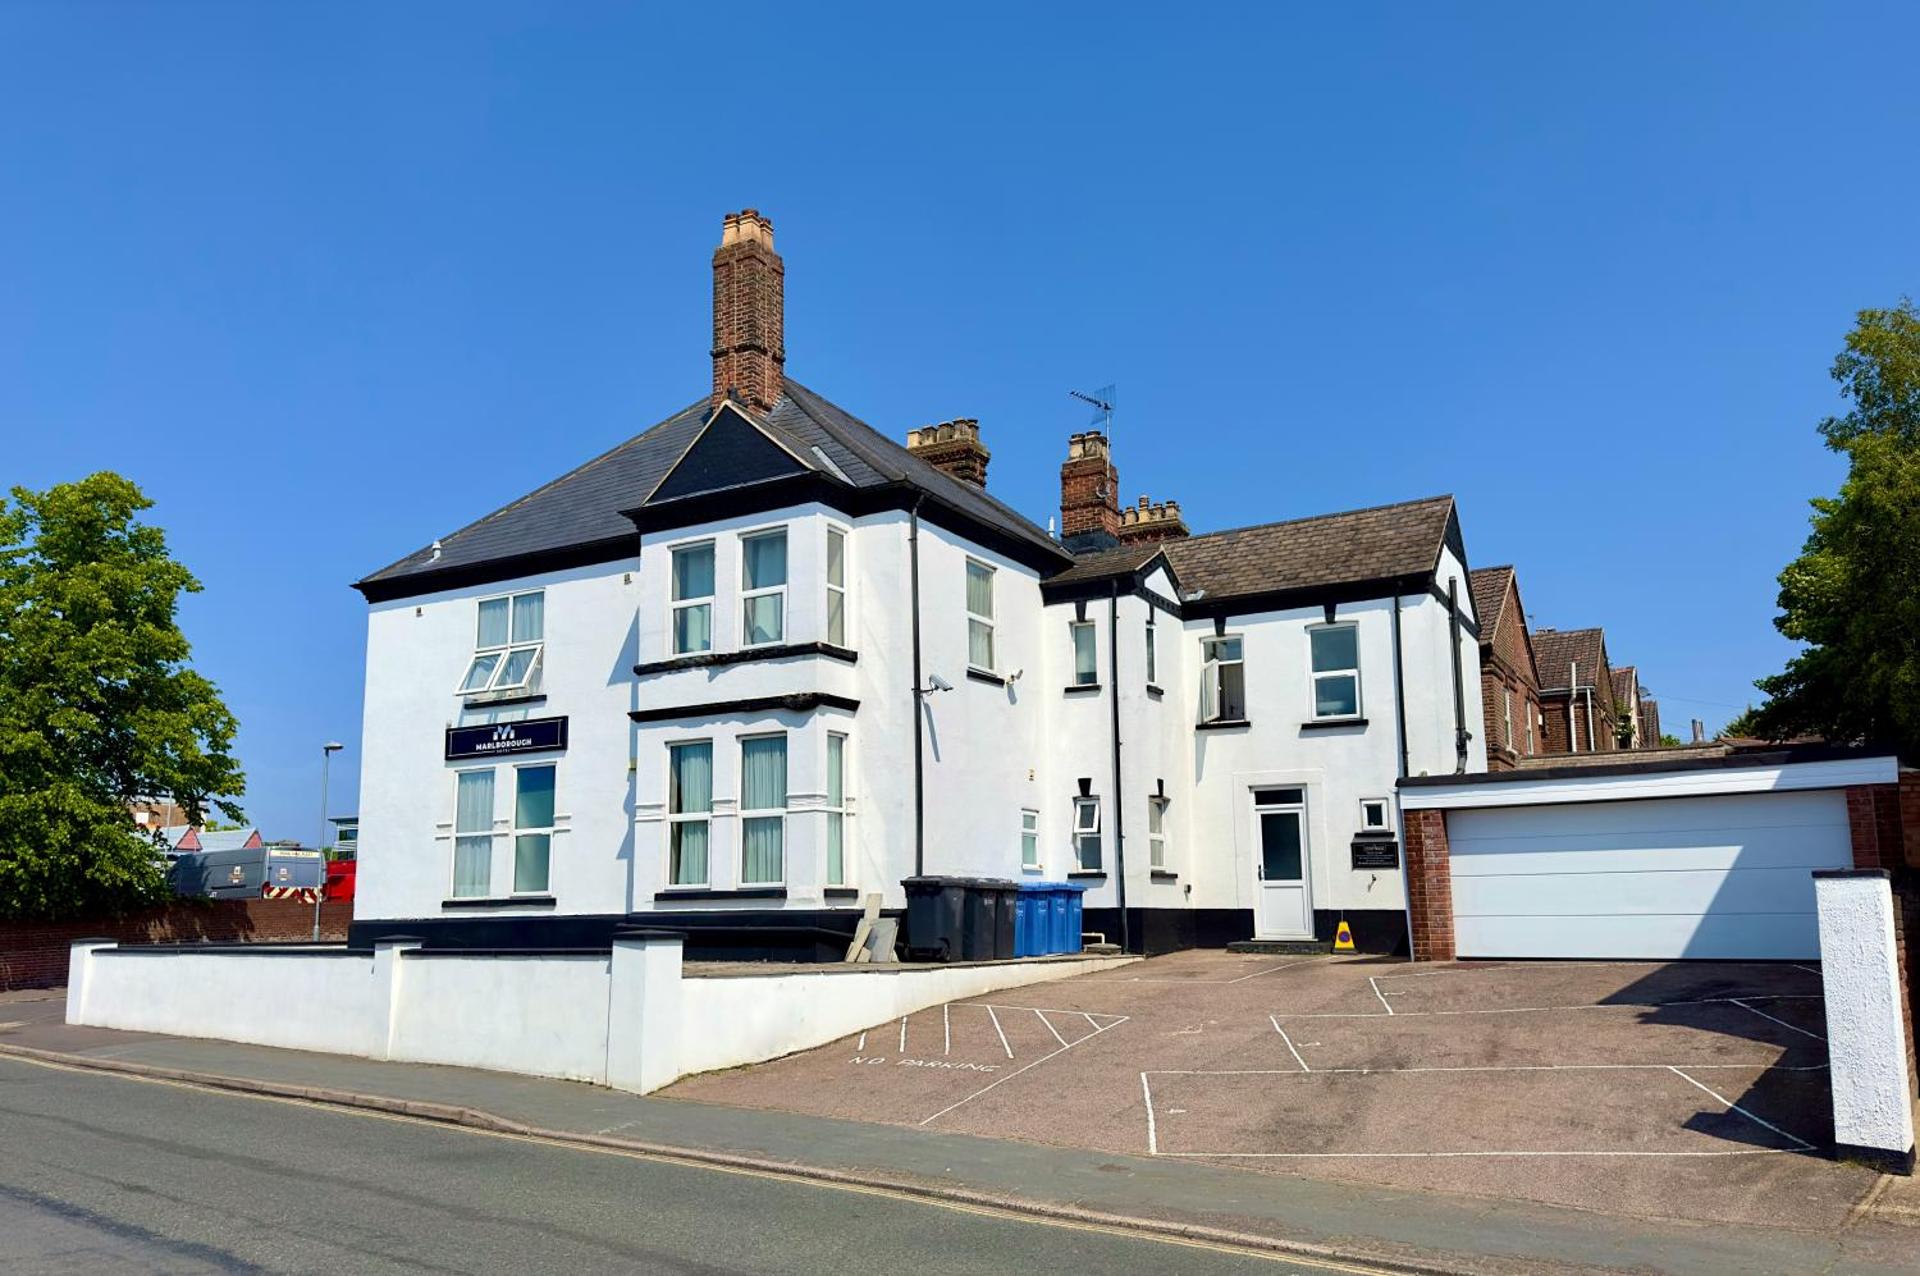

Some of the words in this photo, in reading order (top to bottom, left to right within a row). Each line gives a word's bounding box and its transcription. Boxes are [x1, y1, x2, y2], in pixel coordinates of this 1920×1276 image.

[476, 738, 531, 751] MARLBOROUGH
[849, 1056, 885, 1065] NO
[896, 1059, 1000, 1072] PARKING
